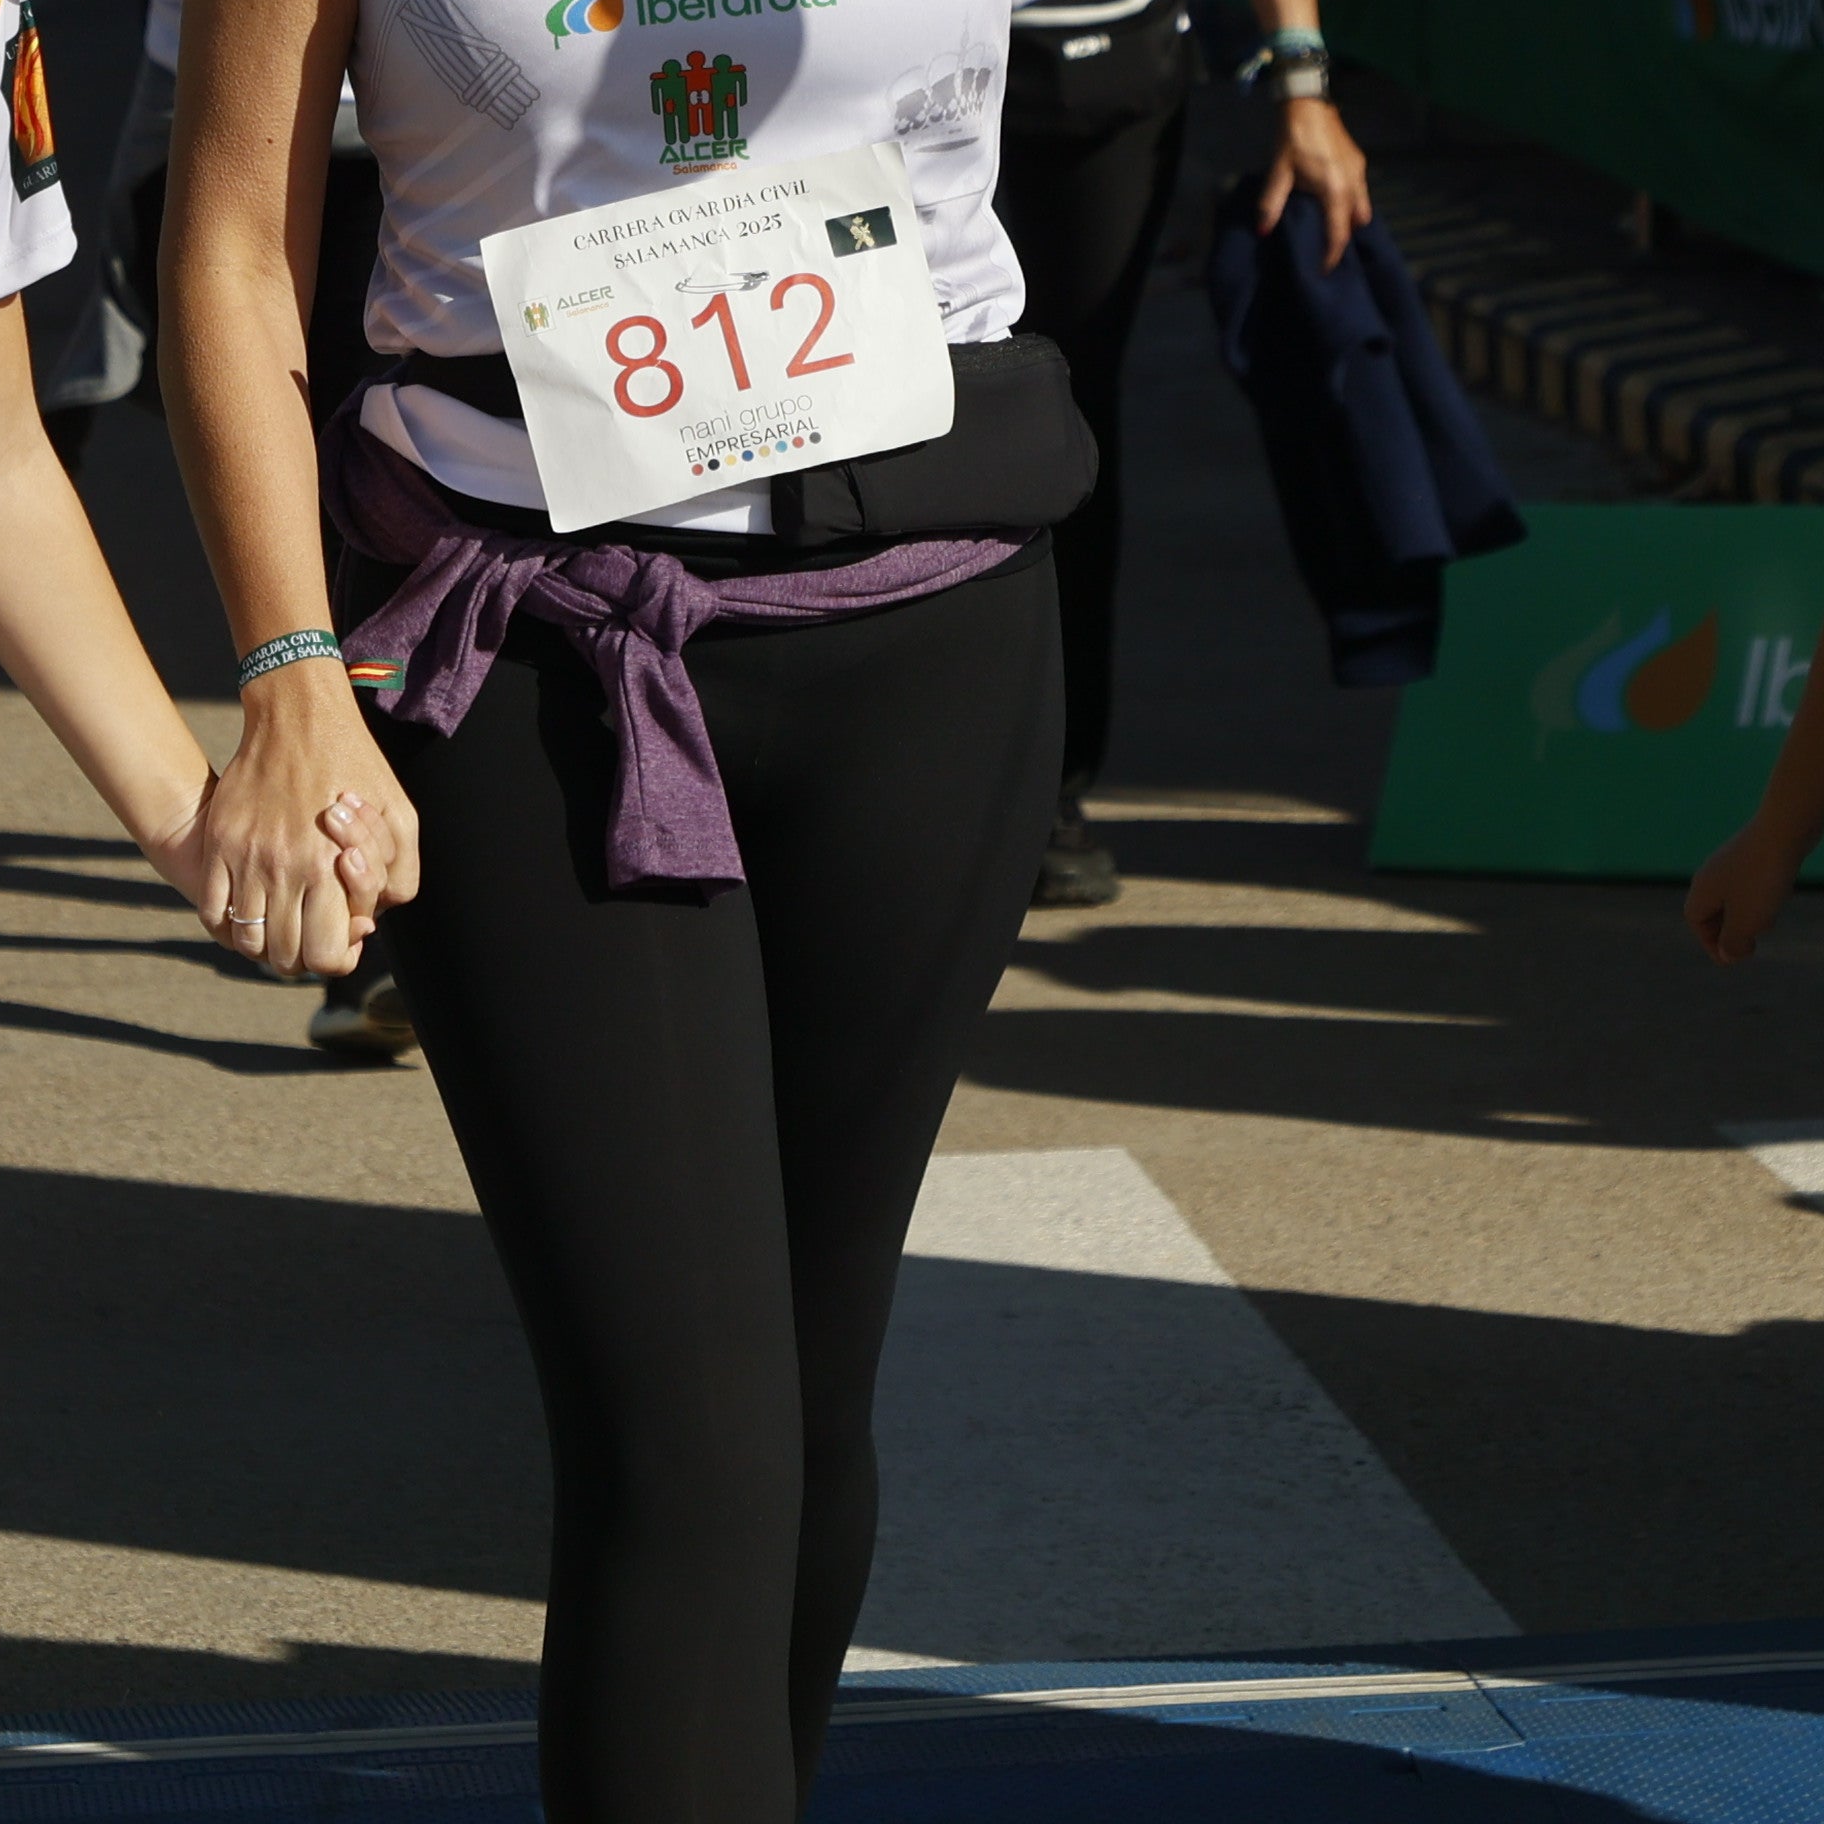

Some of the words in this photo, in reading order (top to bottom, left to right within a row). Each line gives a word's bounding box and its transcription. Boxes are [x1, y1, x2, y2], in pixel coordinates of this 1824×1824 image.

[658, 138, 750, 165] ALCER
[673, 161, 737, 175] Salamanca
[574, 215, 664, 251] CARRERA
[614, 228, 730, 269] SALAMANCA
[738, 213, 782, 238] 2025
[556, 285, 614, 311] ALCER
[605, 272, 855, 417] 812
[679, 409, 732, 443] nani
[739, 395, 813, 433] grupo
[685, 416, 819, 463] EMPRESARIAL
[290, 632, 323, 646] CIVIL
[281, 649, 297, 664] DE
